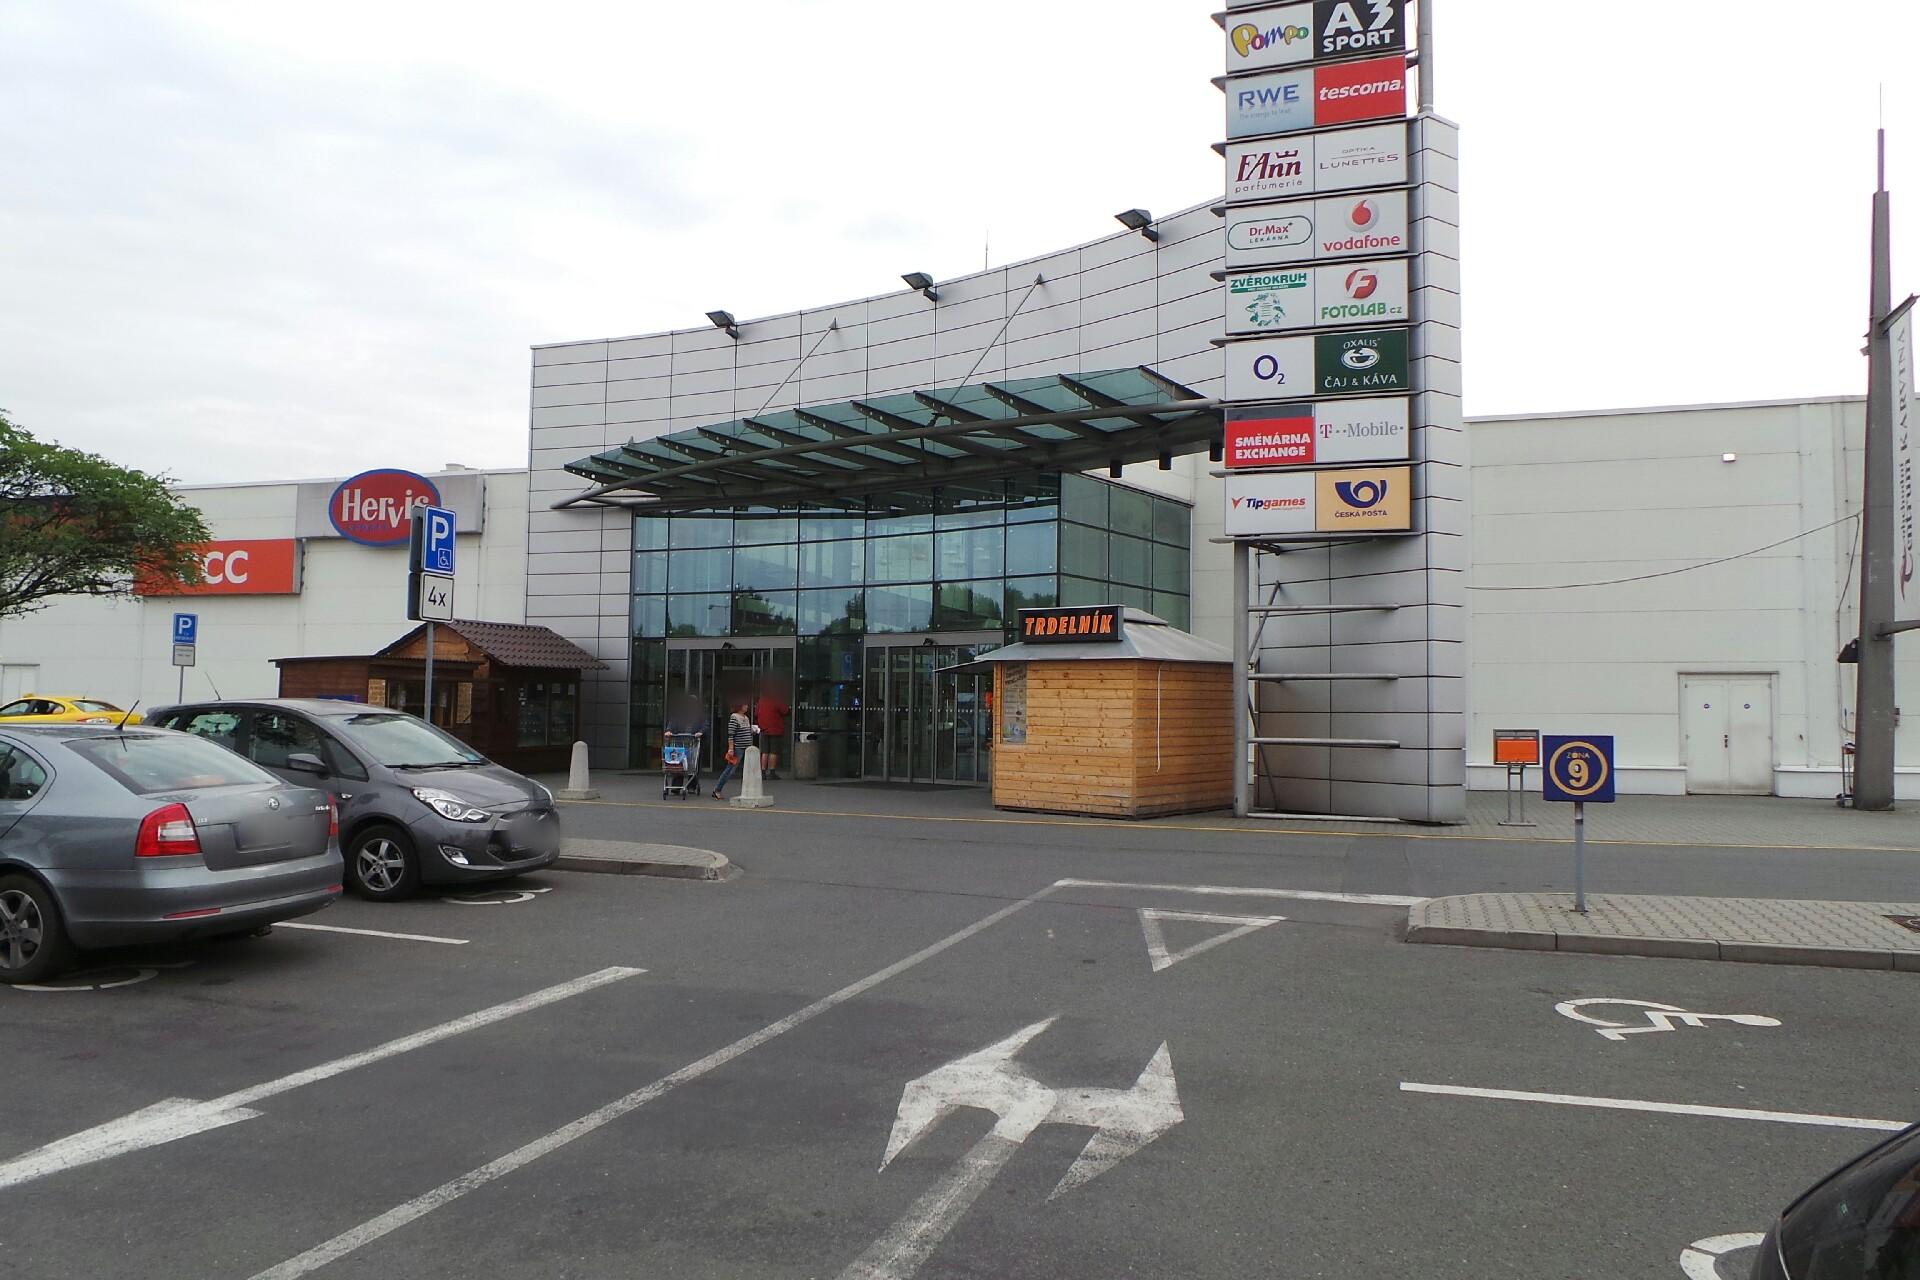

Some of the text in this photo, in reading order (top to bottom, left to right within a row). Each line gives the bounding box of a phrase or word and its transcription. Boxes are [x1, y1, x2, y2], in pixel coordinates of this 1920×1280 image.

[1230, 23, 1309, 57] Pompo
[1322, 28, 1395, 53] SPORT
[1238, 84, 1300, 108] RWE
[1341, 146, 1375, 154] OPTIKA
[1319, 153, 1399, 170] LUNETTES
[1323, 234, 1401, 252] vodafone
[1230, 272, 1307, 288] ZVĚROKRUH
[1343, 338, 1378, 350] OXALIS
[1324, 372, 1397, 388] ČAJ & KÁVA
[1235, 432, 1311, 448] SMĚNÁRNA
[1235, 446, 1306, 460] EXCHANGE
[1246, 496, 1306, 511] Tipgames
[431, 515, 449, 552] P
[428, 586, 446, 608] 4x
[178, 617, 193, 635] P
[1024, 610, 1114, 636] TRDELNÍK
[1567, 759, 1589, 788] 9
